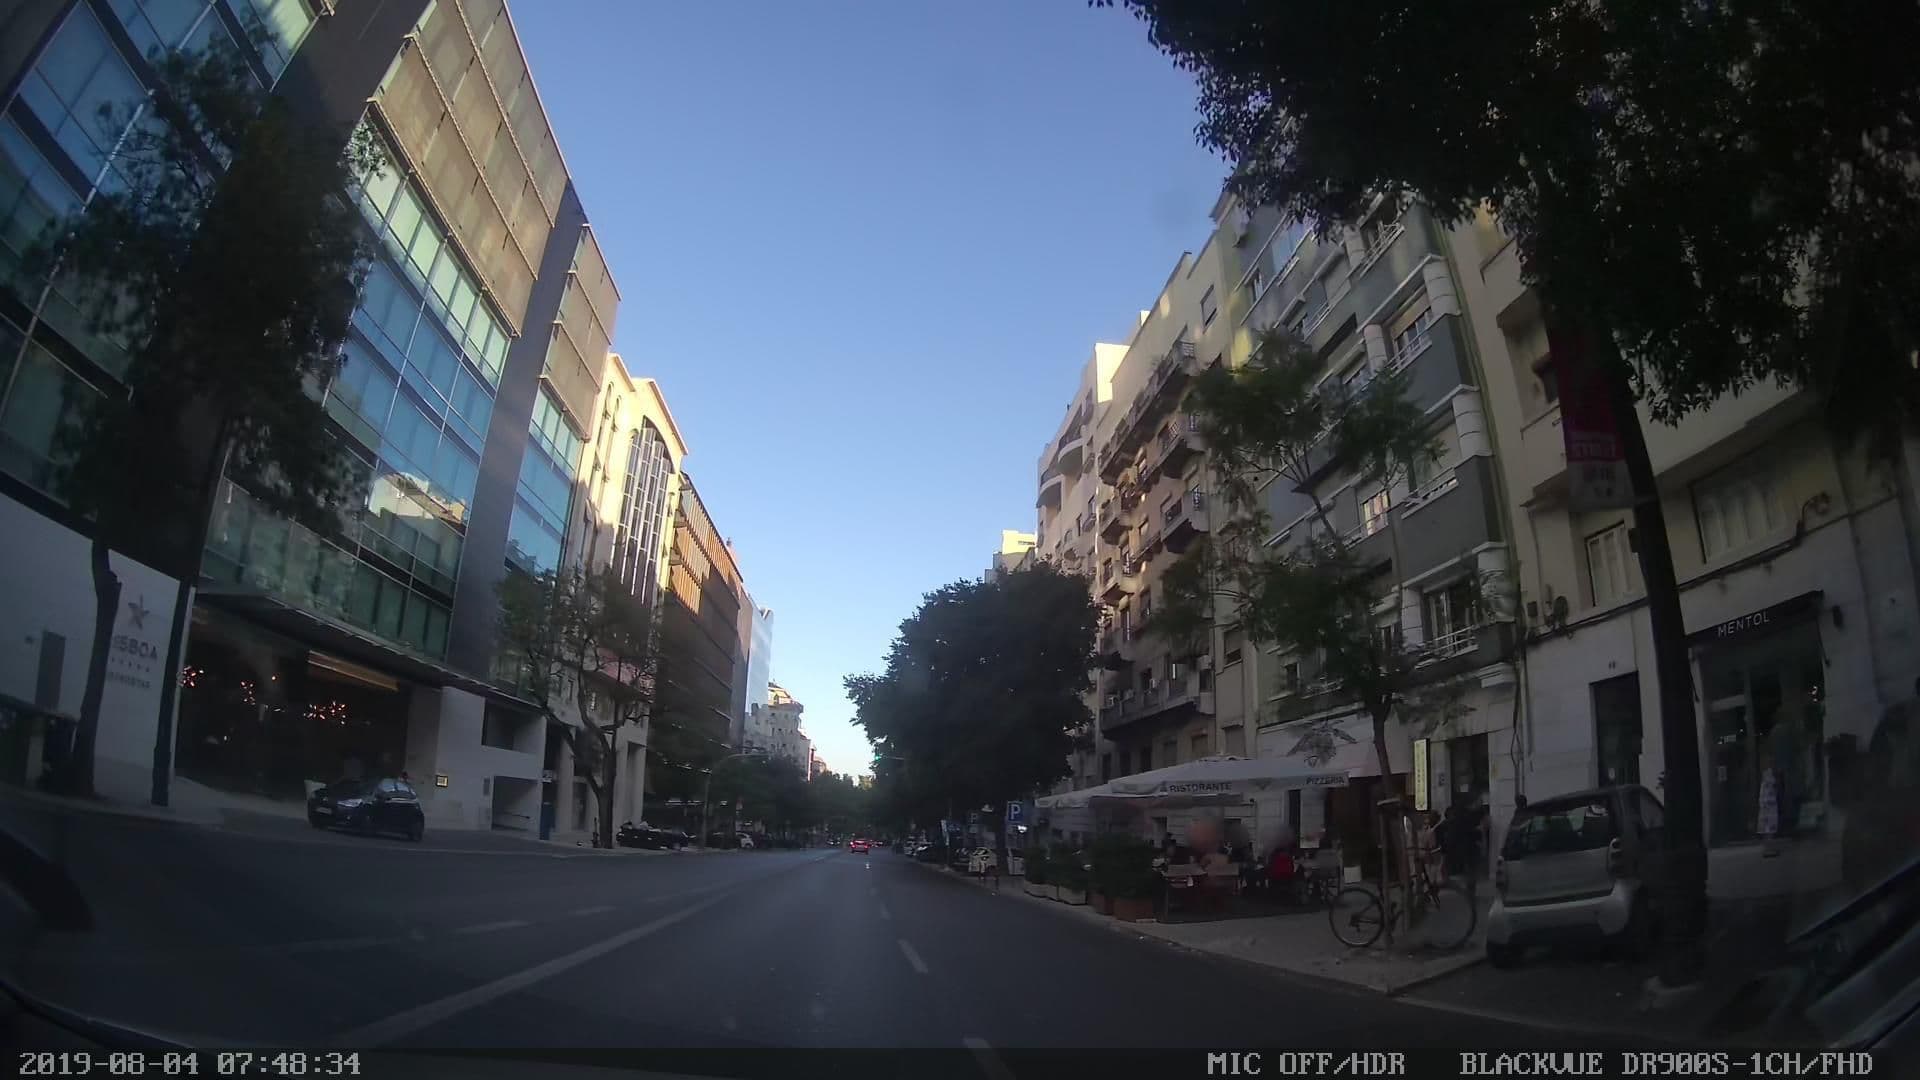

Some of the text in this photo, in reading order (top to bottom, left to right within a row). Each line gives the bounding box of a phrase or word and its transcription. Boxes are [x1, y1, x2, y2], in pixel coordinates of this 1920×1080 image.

[1717, 610, 1770, 637] MENTOL
[1169, 781, 1232, 793] RISTORANTE
[1306, 775, 1345, 785] PIZZERIA
[1010, 803, 1021, 820] P
